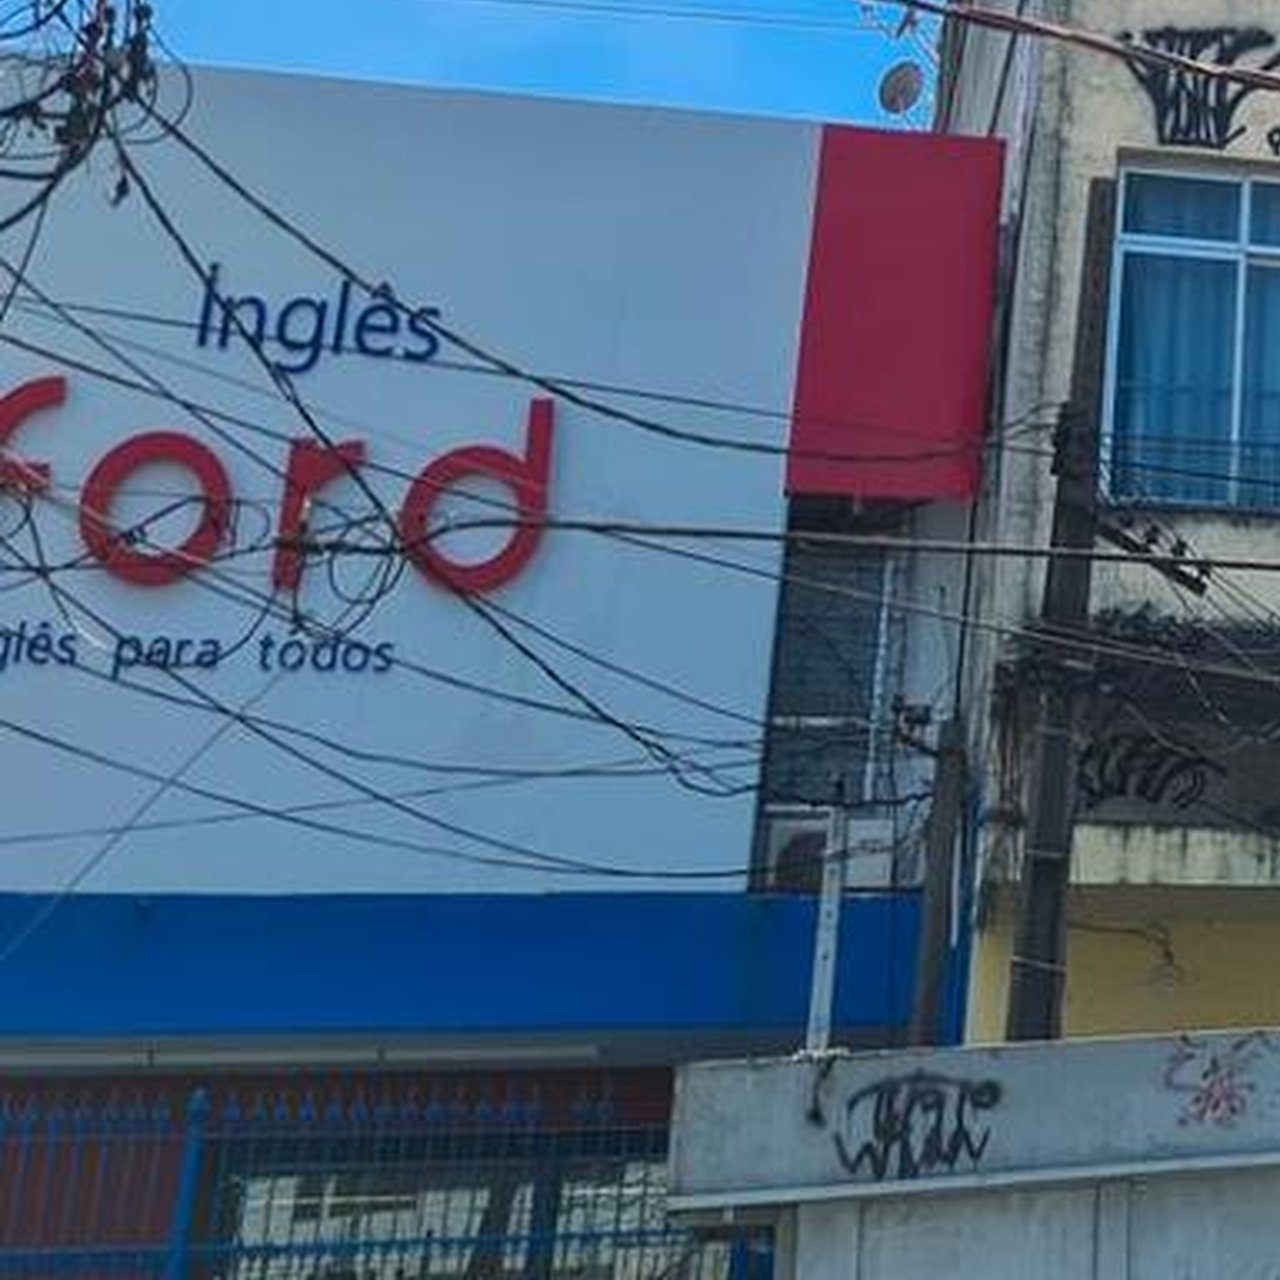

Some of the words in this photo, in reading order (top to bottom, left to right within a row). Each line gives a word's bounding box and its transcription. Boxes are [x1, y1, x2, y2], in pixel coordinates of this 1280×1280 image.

[197, 266, 441, 374] Inglês
[111, 633, 220, 681] para
[258, 630, 395, 673] todos
